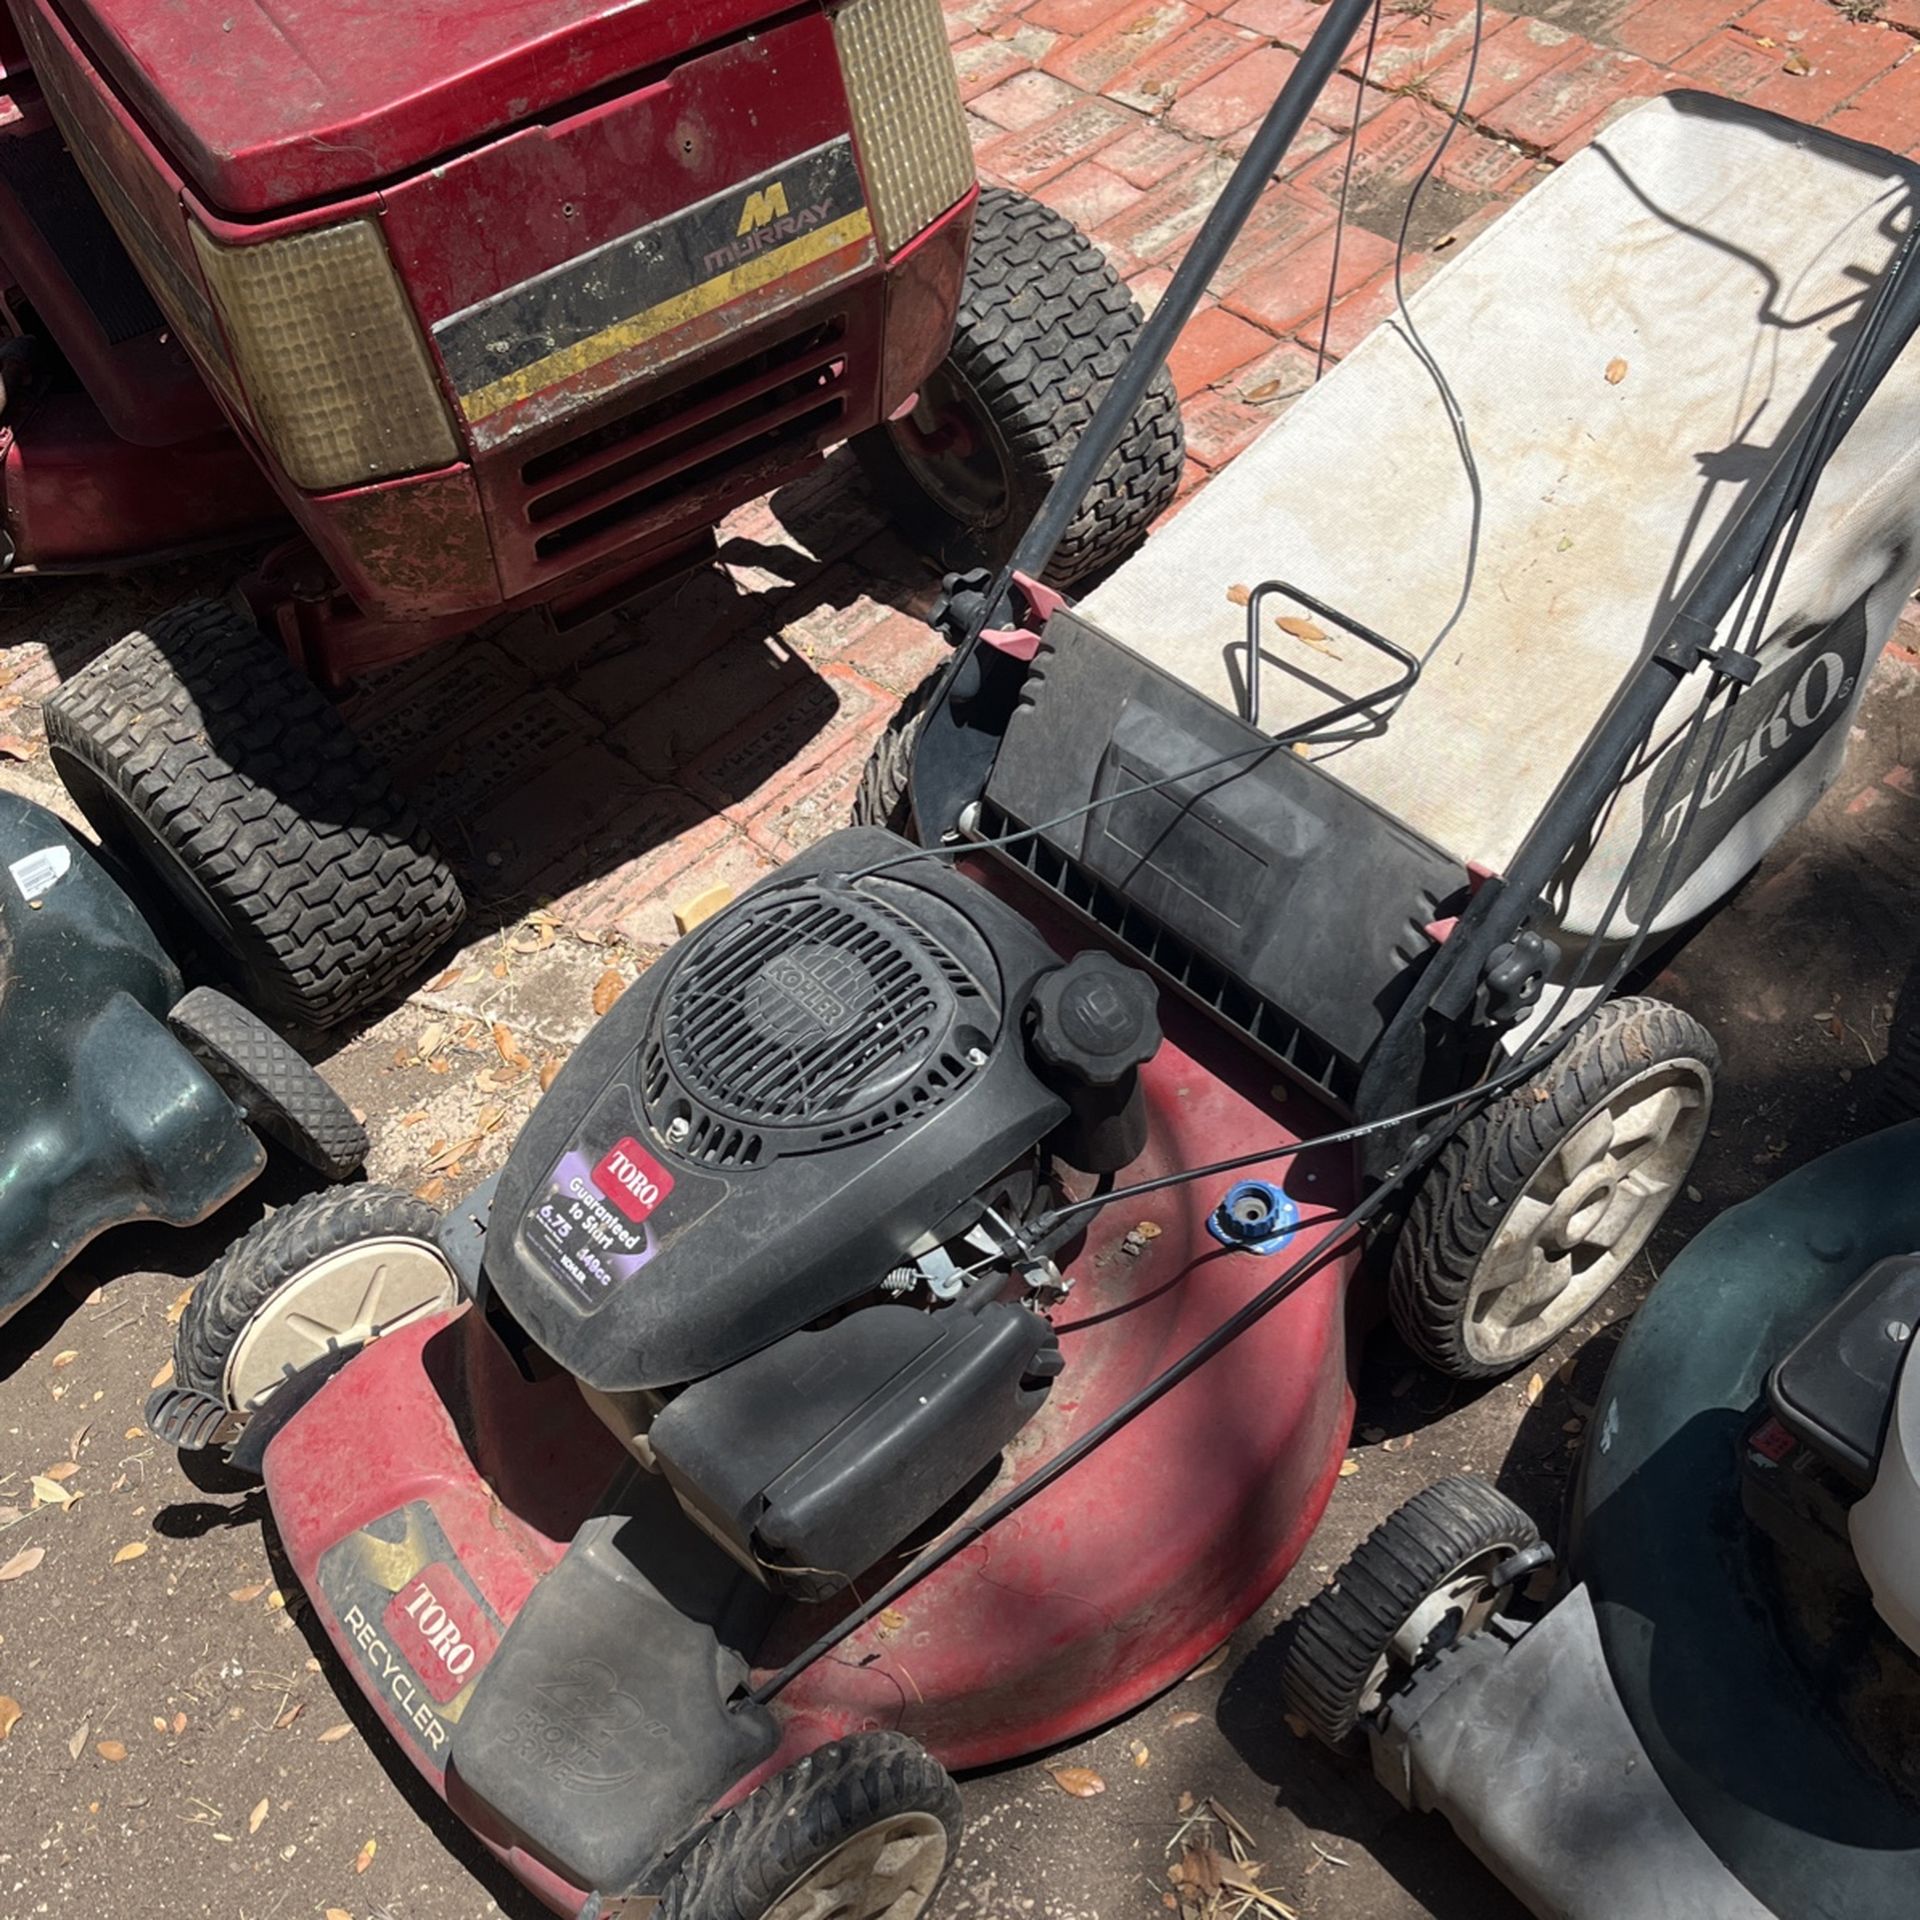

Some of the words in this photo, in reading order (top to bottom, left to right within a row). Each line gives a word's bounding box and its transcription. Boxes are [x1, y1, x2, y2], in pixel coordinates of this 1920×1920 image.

[703, 198, 833, 273] MURRAY
[766, 957, 845, 1026] KOHLER
[607, 1151, 659, 1206] TORO
[540, 1205, 573, 1238] 6.75
[568, 1202, 584, 1220] to
[581, 1215, 614, 1250] Start
[569, 1177, 641, 1250] Guaranteed
[560, 1254, 588, 1285] KOHLER
[404, 1583, 476, 1676] TORO
[344, 1605, 448, 1751] RECYCLER
[498, 1725, 576, 1783] DRIVE
[513, 1705, 600, 1768] FRONT
